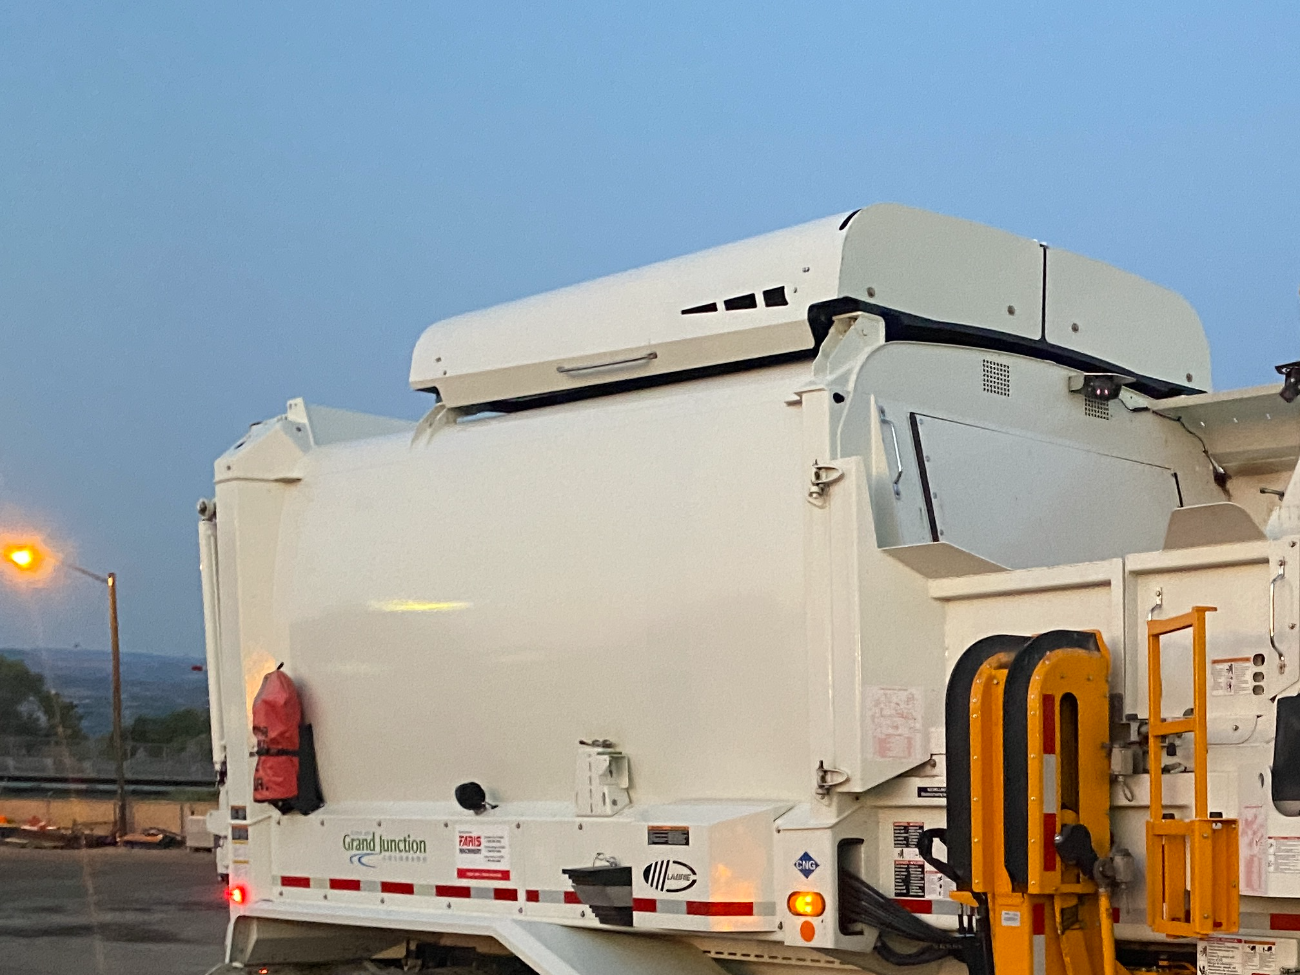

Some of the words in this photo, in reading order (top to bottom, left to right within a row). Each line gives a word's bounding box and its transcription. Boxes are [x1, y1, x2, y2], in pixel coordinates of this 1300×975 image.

[342, 832, 376, 851] Grand
[379, 833, 427, 855] Junction
[796, 860, 816, 870] CNG
